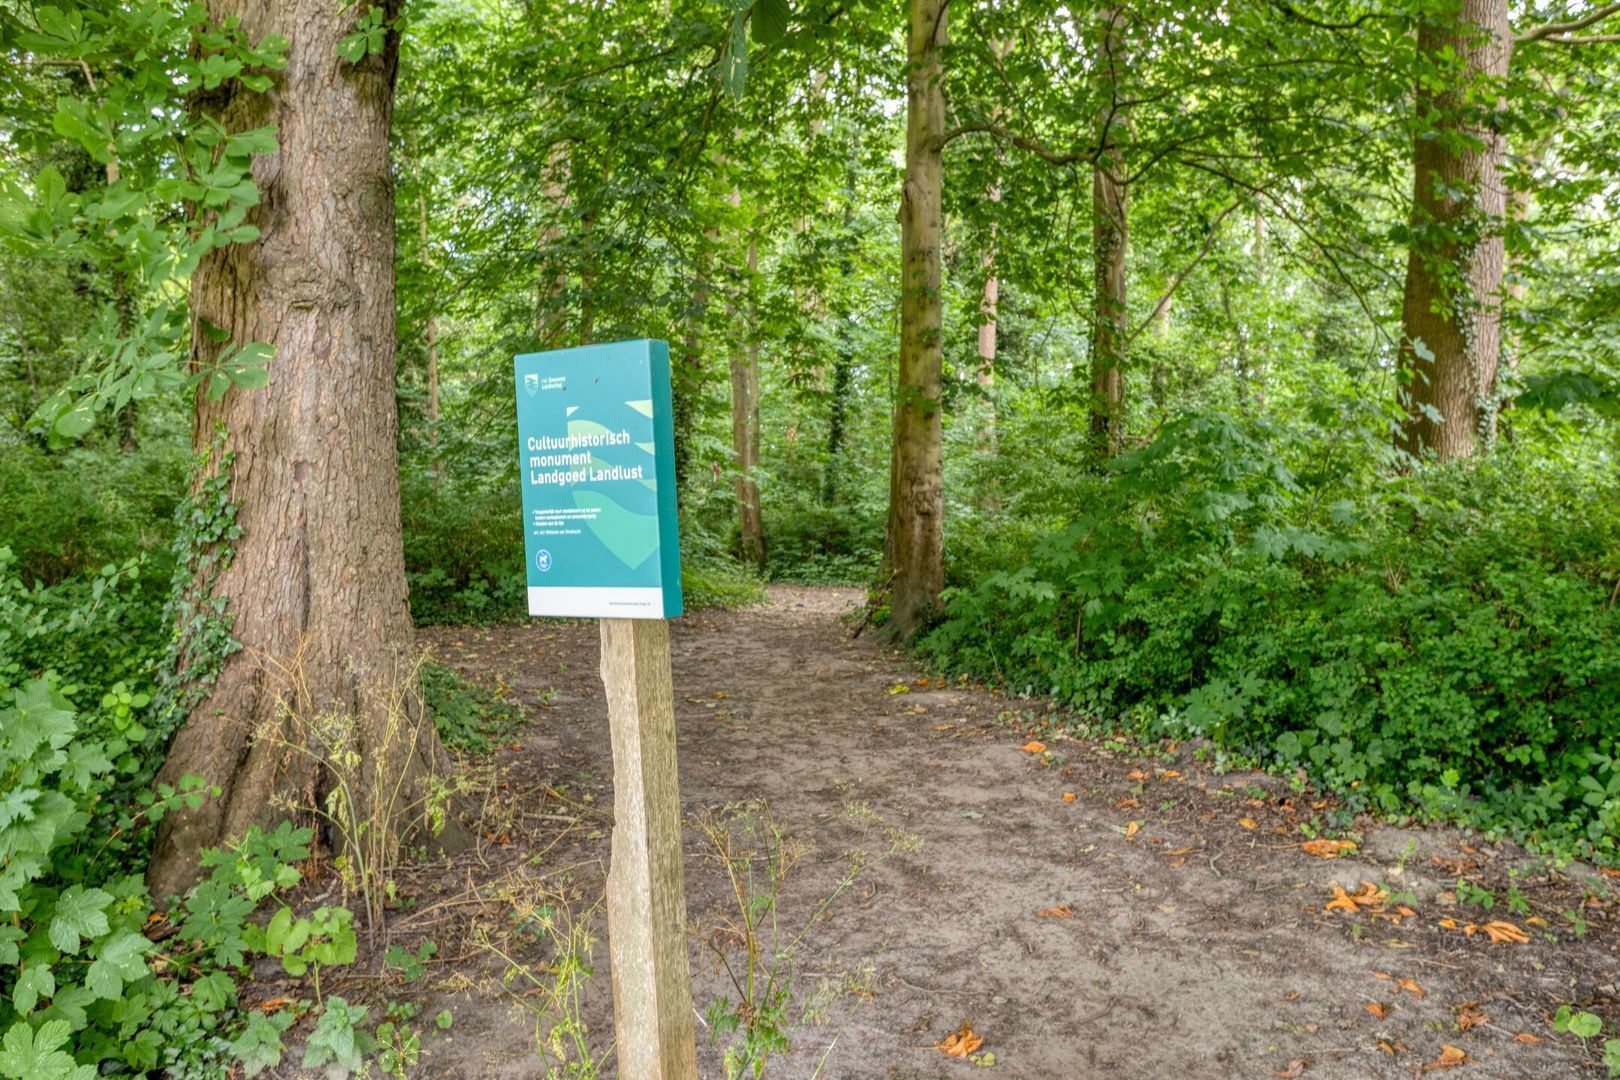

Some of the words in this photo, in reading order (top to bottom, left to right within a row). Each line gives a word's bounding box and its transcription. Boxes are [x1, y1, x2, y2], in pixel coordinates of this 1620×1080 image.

[527, 429, 630, 451] Cultuurhistorisch
[530, 450, 592, 468] monument
[530, 468, 586, 487] Landgoed
[589, 465, 643, 482] Landlust
